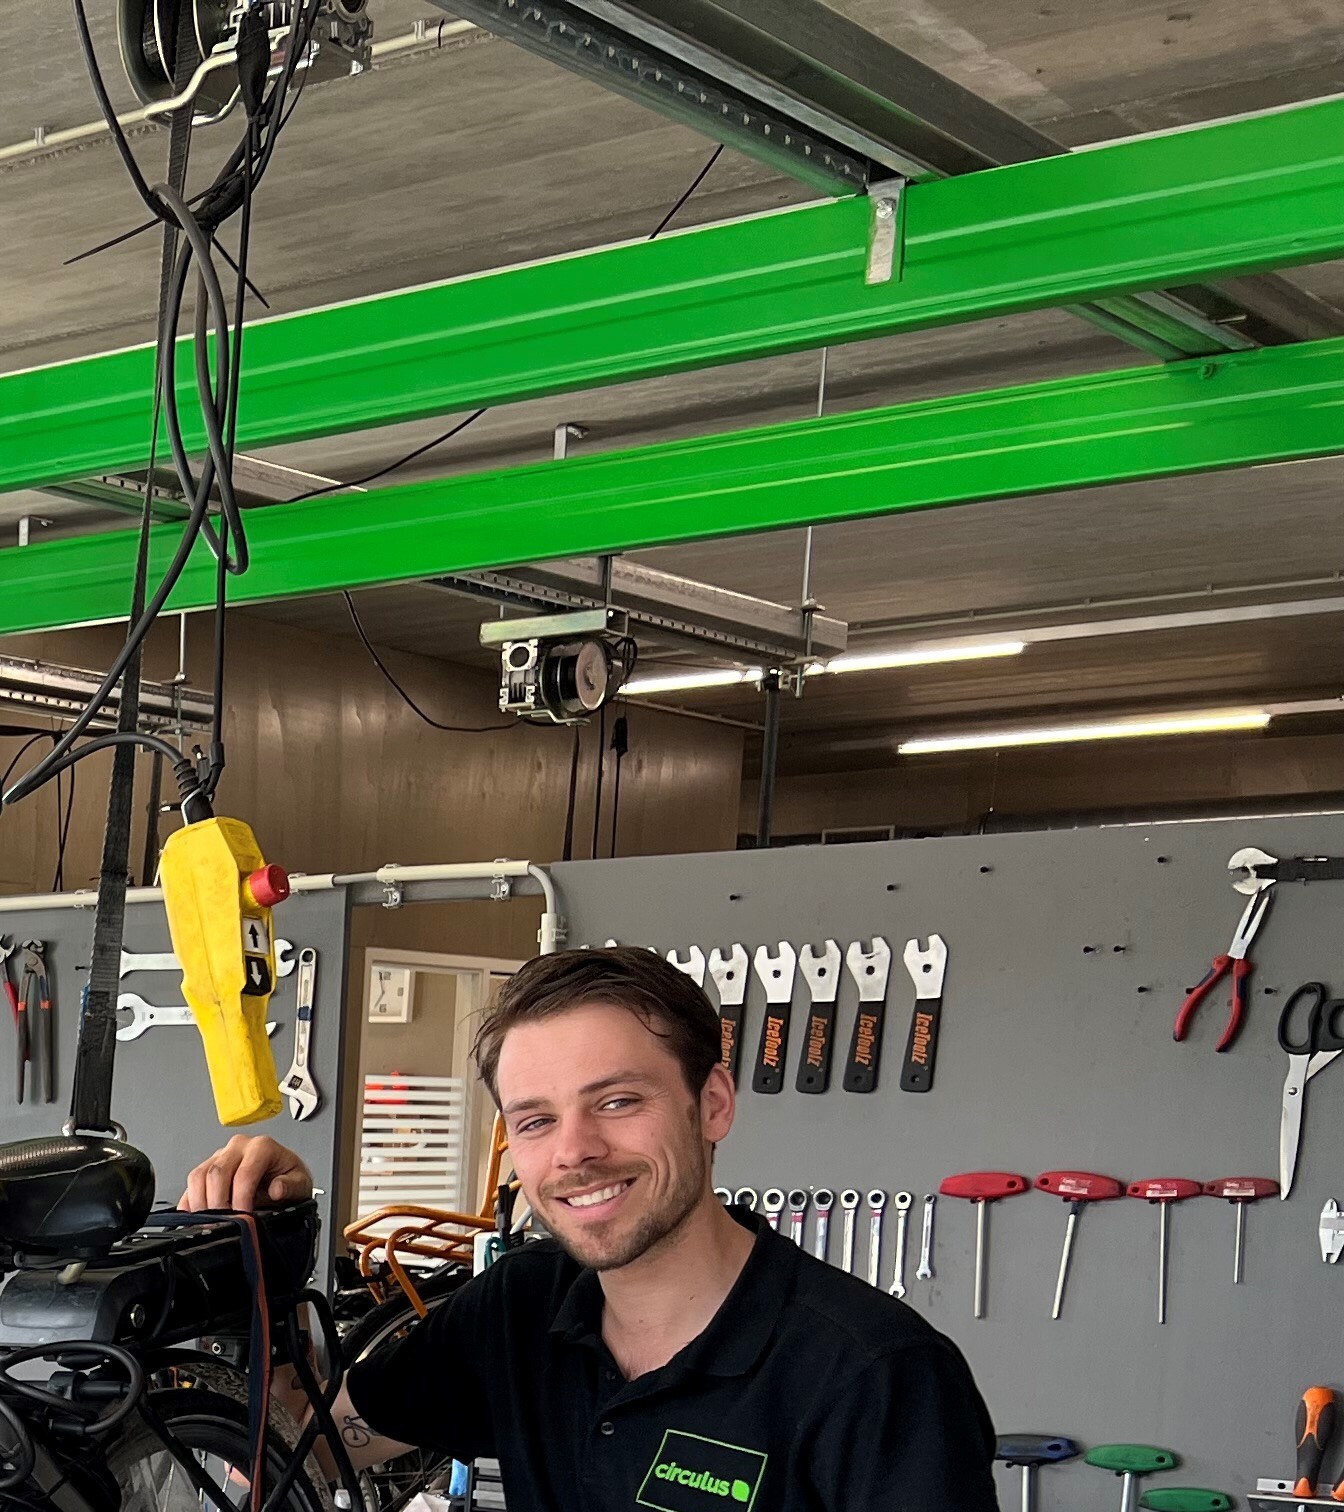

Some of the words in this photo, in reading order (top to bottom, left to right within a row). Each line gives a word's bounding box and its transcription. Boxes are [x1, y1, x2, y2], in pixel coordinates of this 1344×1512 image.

[764, 1016, 784, 1067] IceToolz
[807, 1016, 828, 1067] IceToolz
[855, 1013, 877, 1065] IceToolz
[912, 1012, 933, 1065] IceToolz
[655, 1462, 730, 1497] circulus
